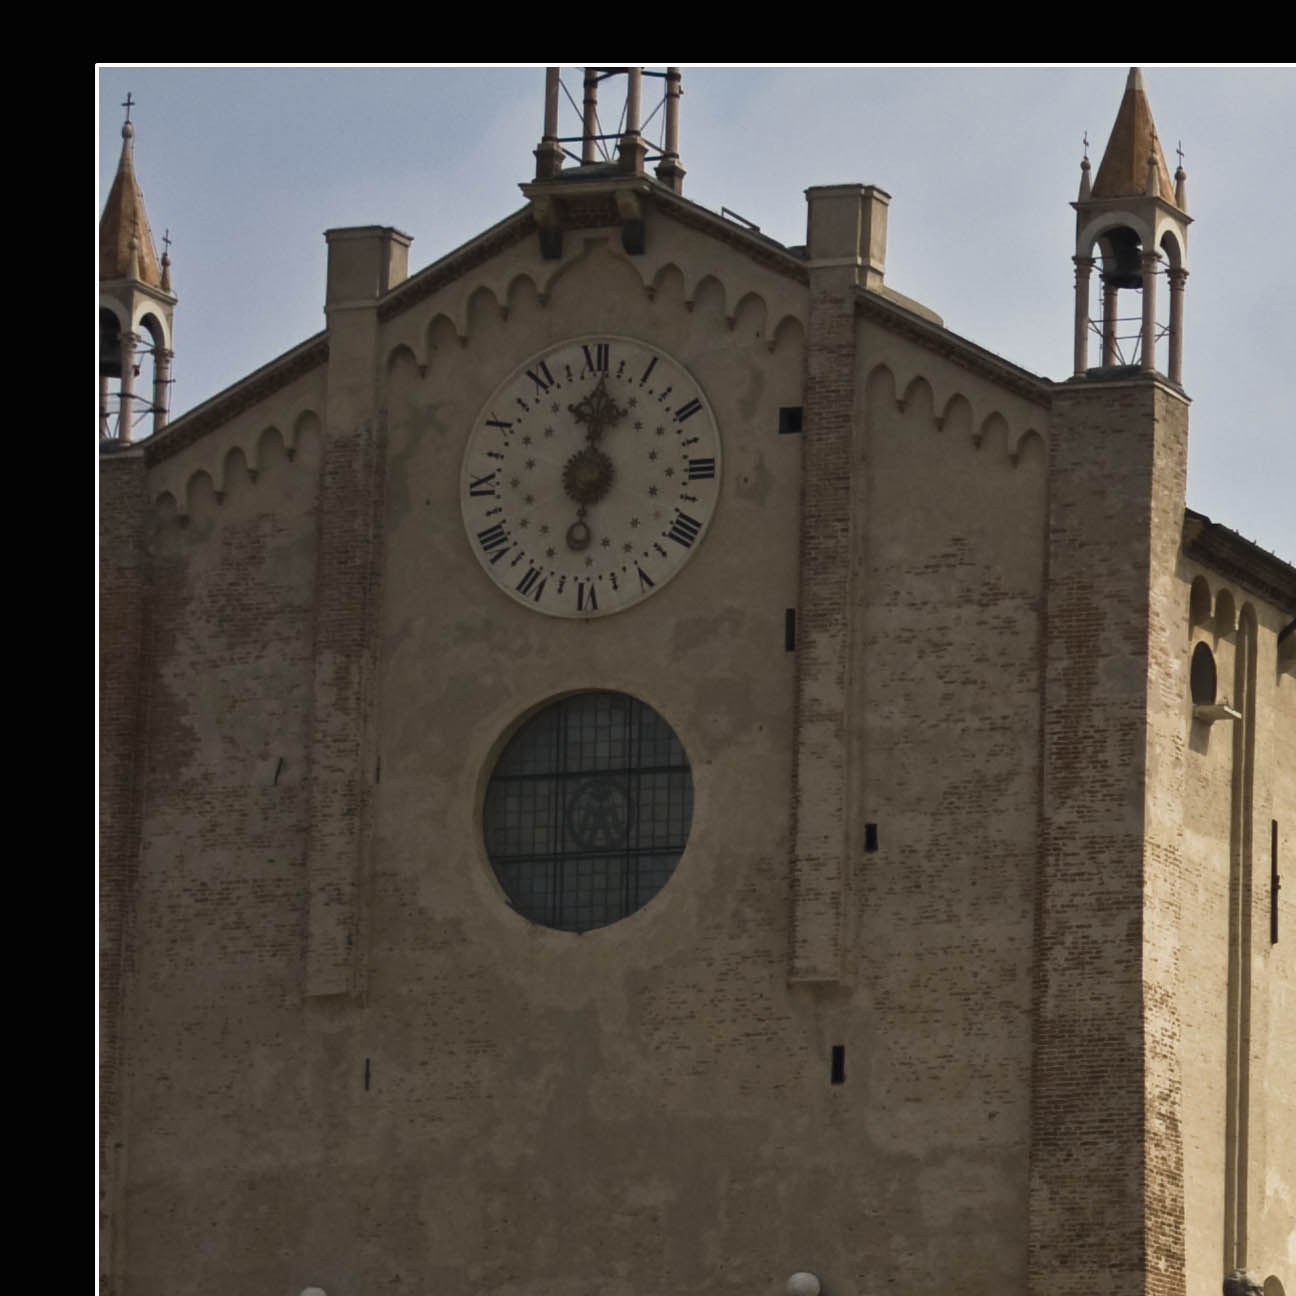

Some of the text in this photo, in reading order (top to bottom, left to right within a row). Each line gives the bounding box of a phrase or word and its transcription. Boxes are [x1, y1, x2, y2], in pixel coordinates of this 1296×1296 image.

[584, 344, 609, 372] XII
[526, 361, 555, 390] XI
[675, 398, 703, 423] II
[688, 458, 715, 480] III
[470, 473, 496, 497] IX
[668, 512, 702, 549] IIII
[637, 567, 655, 593] V
[576, 582, 598, 611] VI
